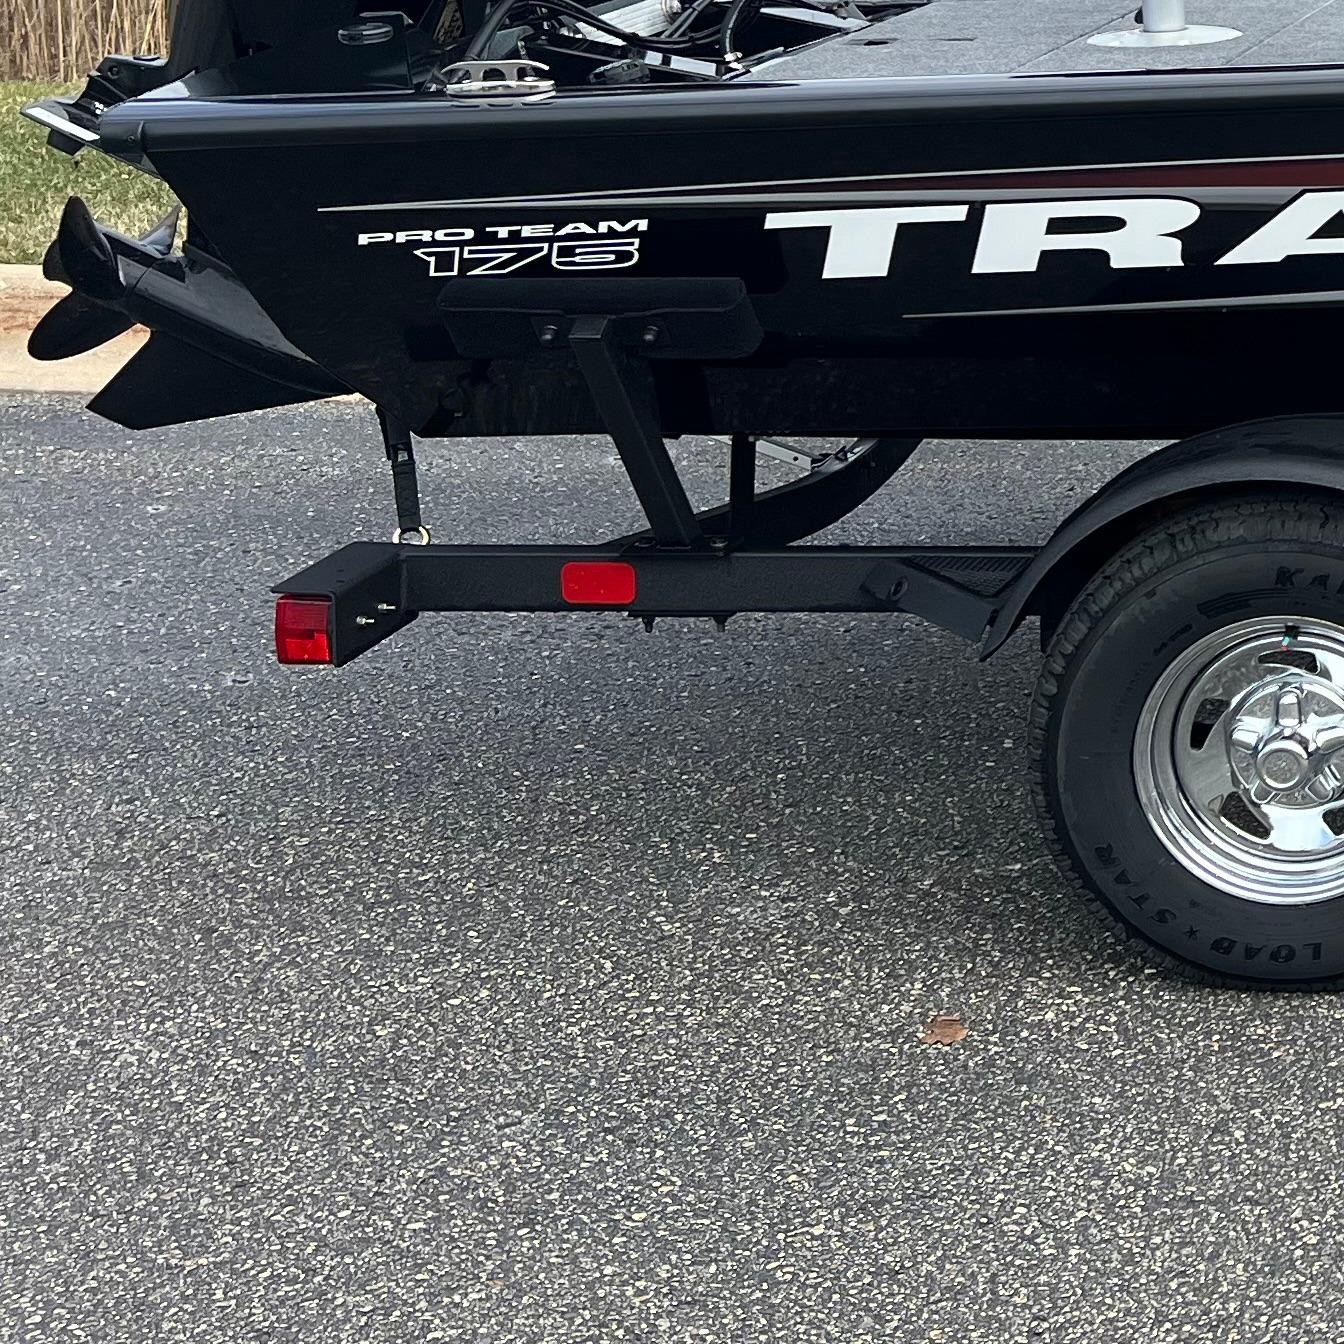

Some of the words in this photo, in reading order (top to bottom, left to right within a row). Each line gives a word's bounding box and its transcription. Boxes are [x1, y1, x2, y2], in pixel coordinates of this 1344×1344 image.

[357, 228, 475, 246] PRO
[485, 218, 649, 239] TEAM
[412, 237, 641, 277] 175
